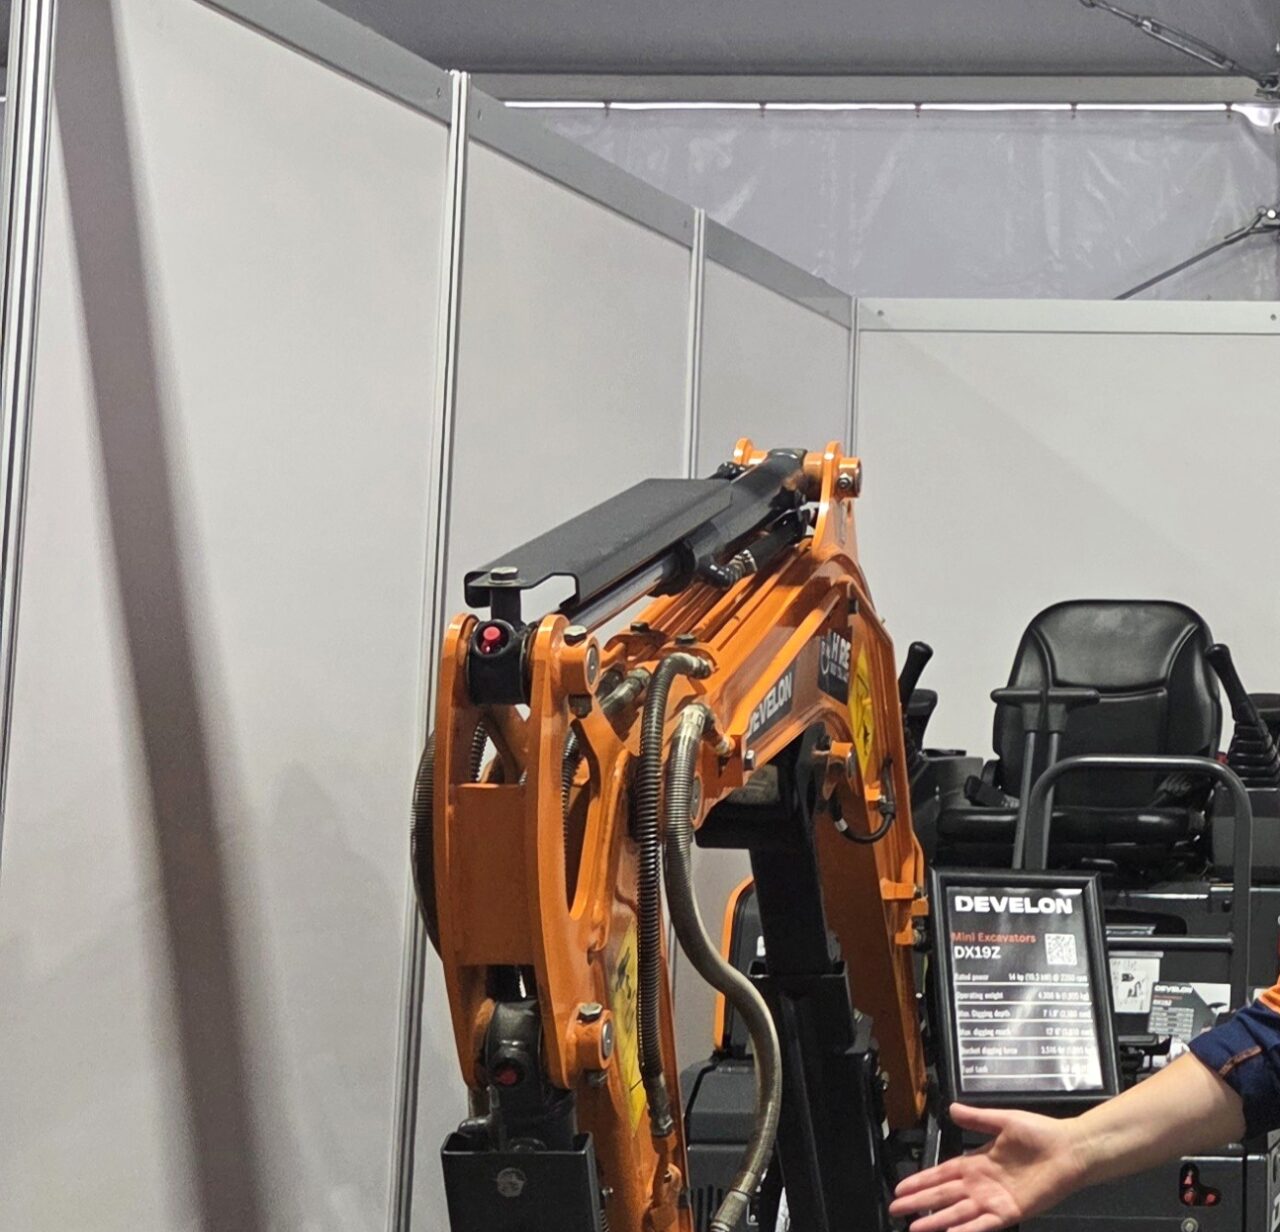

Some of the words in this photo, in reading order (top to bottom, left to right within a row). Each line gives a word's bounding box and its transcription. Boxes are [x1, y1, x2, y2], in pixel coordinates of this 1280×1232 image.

[955, 896, 1073, 914] DEVELON
[952, 931, 976, 943] Mini
[978, 932, 1037, 944] Excavators
[954, 945, 1001, 959] DX19Z
